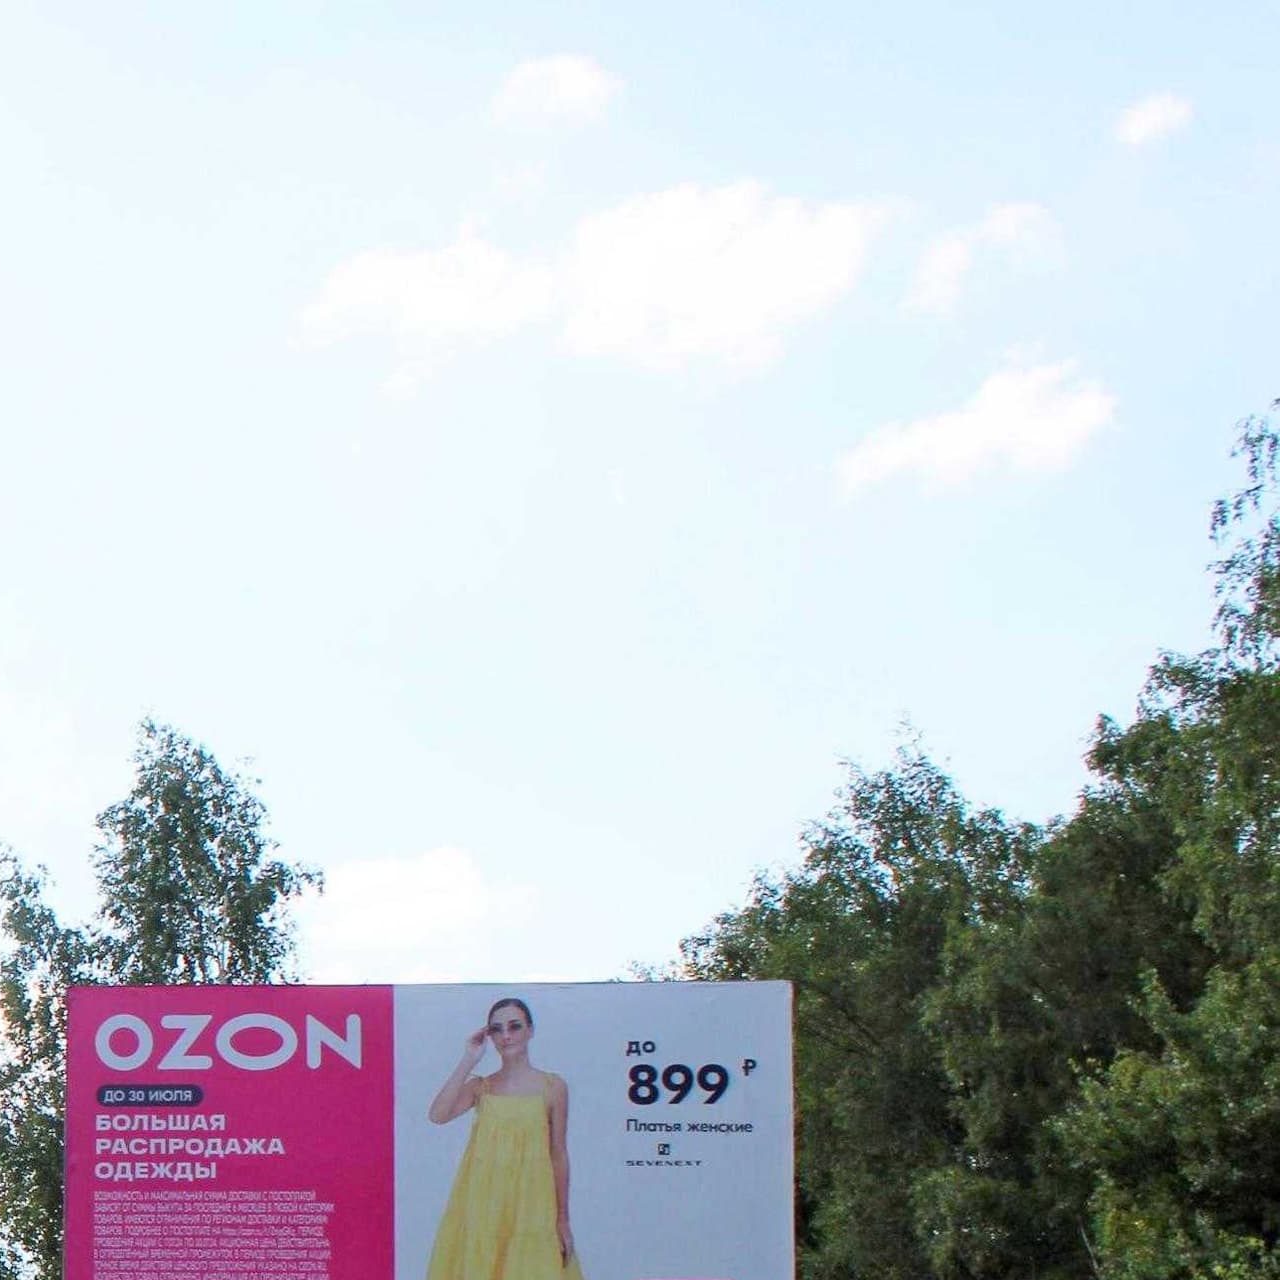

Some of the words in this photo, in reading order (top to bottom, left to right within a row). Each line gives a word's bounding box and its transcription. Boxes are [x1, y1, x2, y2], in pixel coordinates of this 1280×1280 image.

[95, 1013, 361, 1071] OZON
[626, 1041, 656, 1056] до
[628, 1064, 730, 1105] 899
[104, 1090, 125, 1103] ДО
[128, 1090, 144, 1101] 30
[149, 1090, 192, 1101] ИЮЛЯ
[95, 1114, 226, 1131] БОЛЬШАЯ
[626, 1119, 682, 1132] Платья
[687, 1121, 753, 1133] женские
[95, 1138, 286, 1158] РАСПРОДАЖА
[94, 1162, 217, 1181] ОДЕЖДЫ
